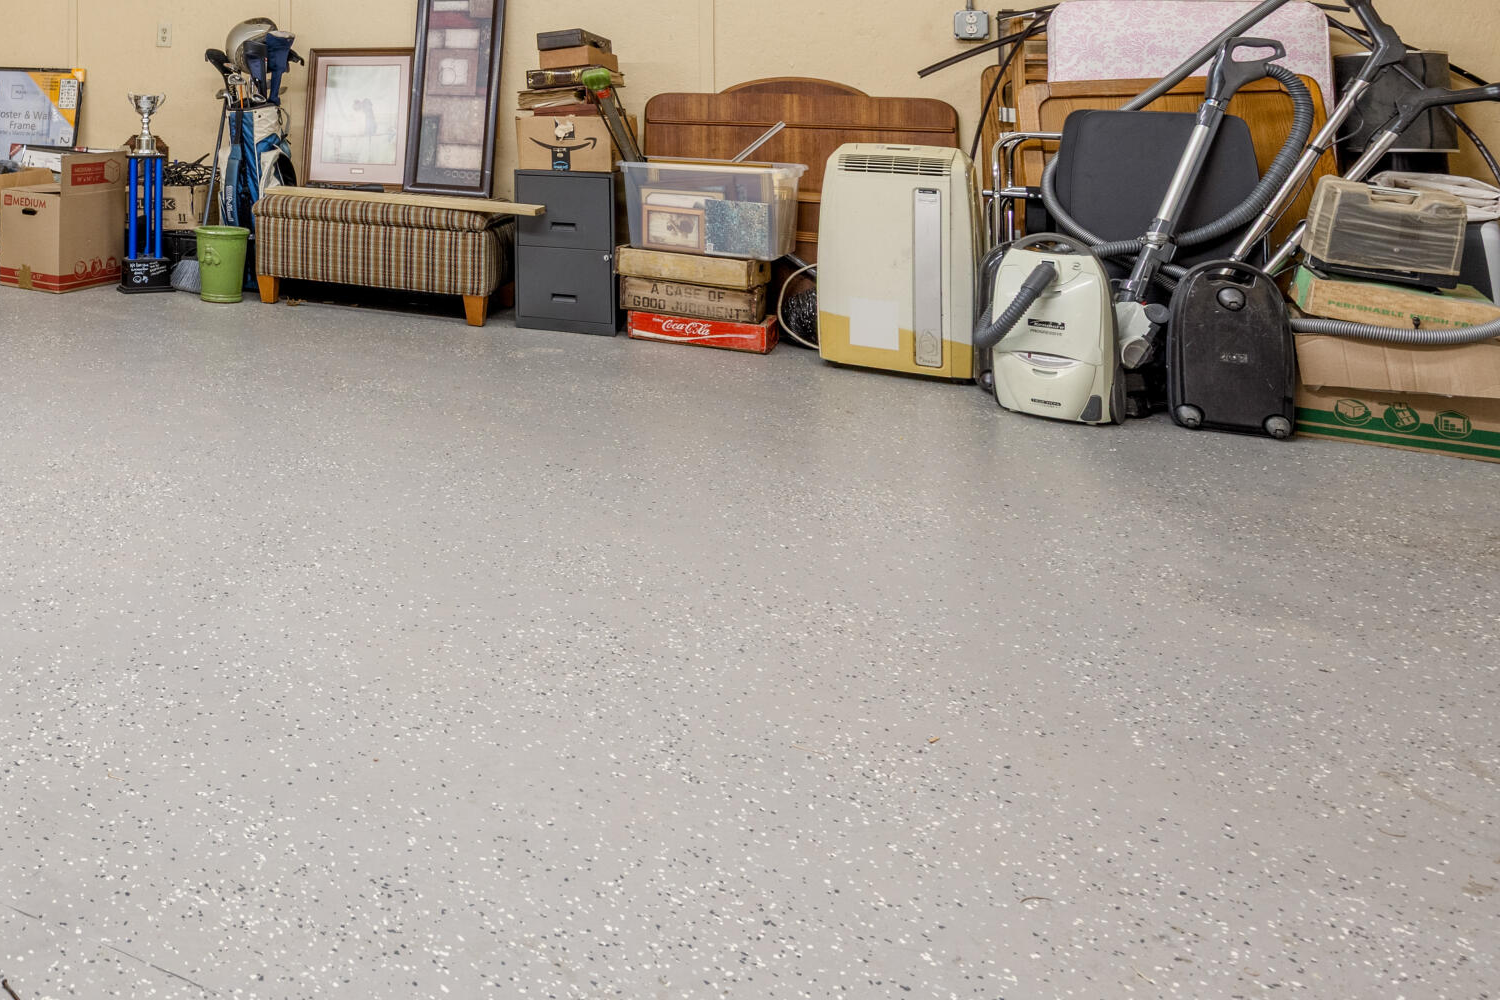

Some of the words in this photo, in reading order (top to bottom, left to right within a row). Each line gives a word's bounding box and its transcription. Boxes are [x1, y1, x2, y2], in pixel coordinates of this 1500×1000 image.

[24, 111, 30, 120] &
[9, 120, 36, 131] Frame
[12, 197, 47, 209] MEDIUM
[651, 283, 660, 295] A
[665, 284, 701, 299] CASE
[707, 290, 726, 303] OF
[627, 294, 666, 310] "GOOD
[1327, 299, 1404, 319] PERISHABLE
[1410, 312, 1450, 326] FRESH
[1034, 322, 1065, 331] Kenmore
